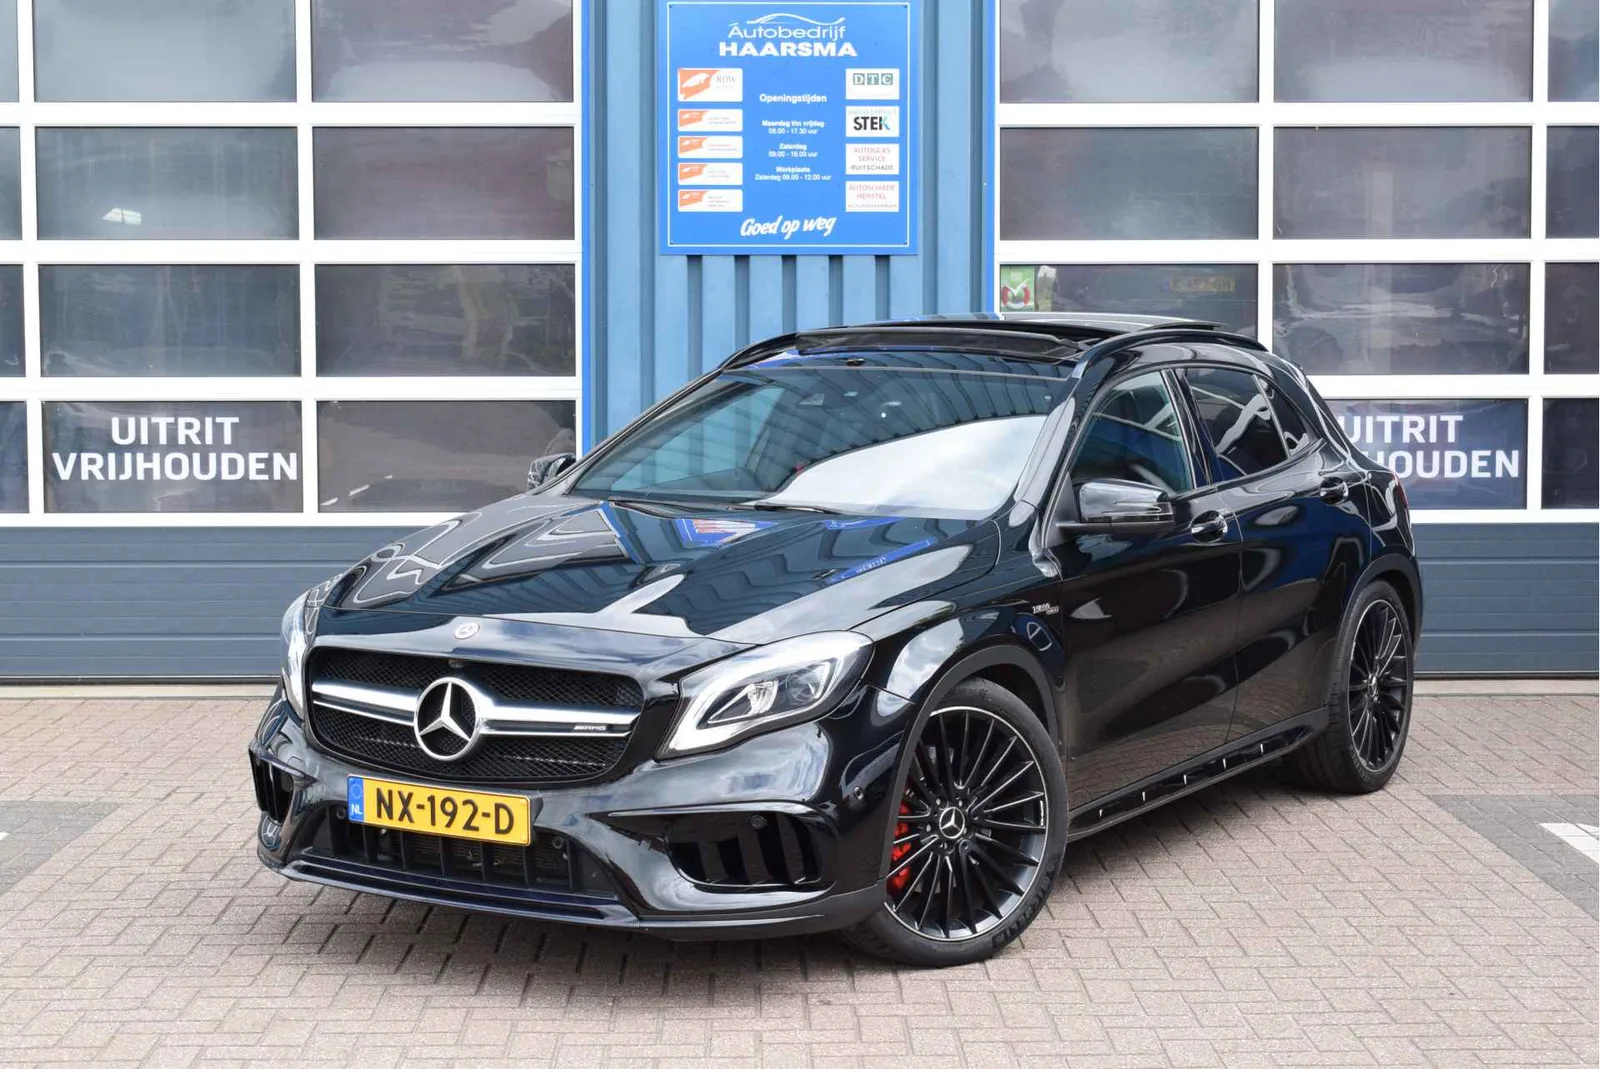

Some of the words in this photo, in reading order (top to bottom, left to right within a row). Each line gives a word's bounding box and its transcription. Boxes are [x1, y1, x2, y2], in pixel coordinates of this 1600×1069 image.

[728, 24, 846, 41] Autobedrijf
[719, 42, 858, 57] HAARSMA
[853, 73, 893, 85] DTC
[759, 93, 828, 104] Openingstijden
[803, 120, 825, 128] vrijdag
[853, 116, 891, 131] STEK
[755, 174, 781, 182] Zaterdag
[740, 215, 784, 236] Goed
[781, 220, 801, 240] op
[803, 216, 837, 237] weg
[111, 416, 239, 445] UITRIT
[51, 452, 298, 481] VRIJHOUDEN
[351, 803, 363, 816] NL
[375, 787, 515, 836] NX-192-D
